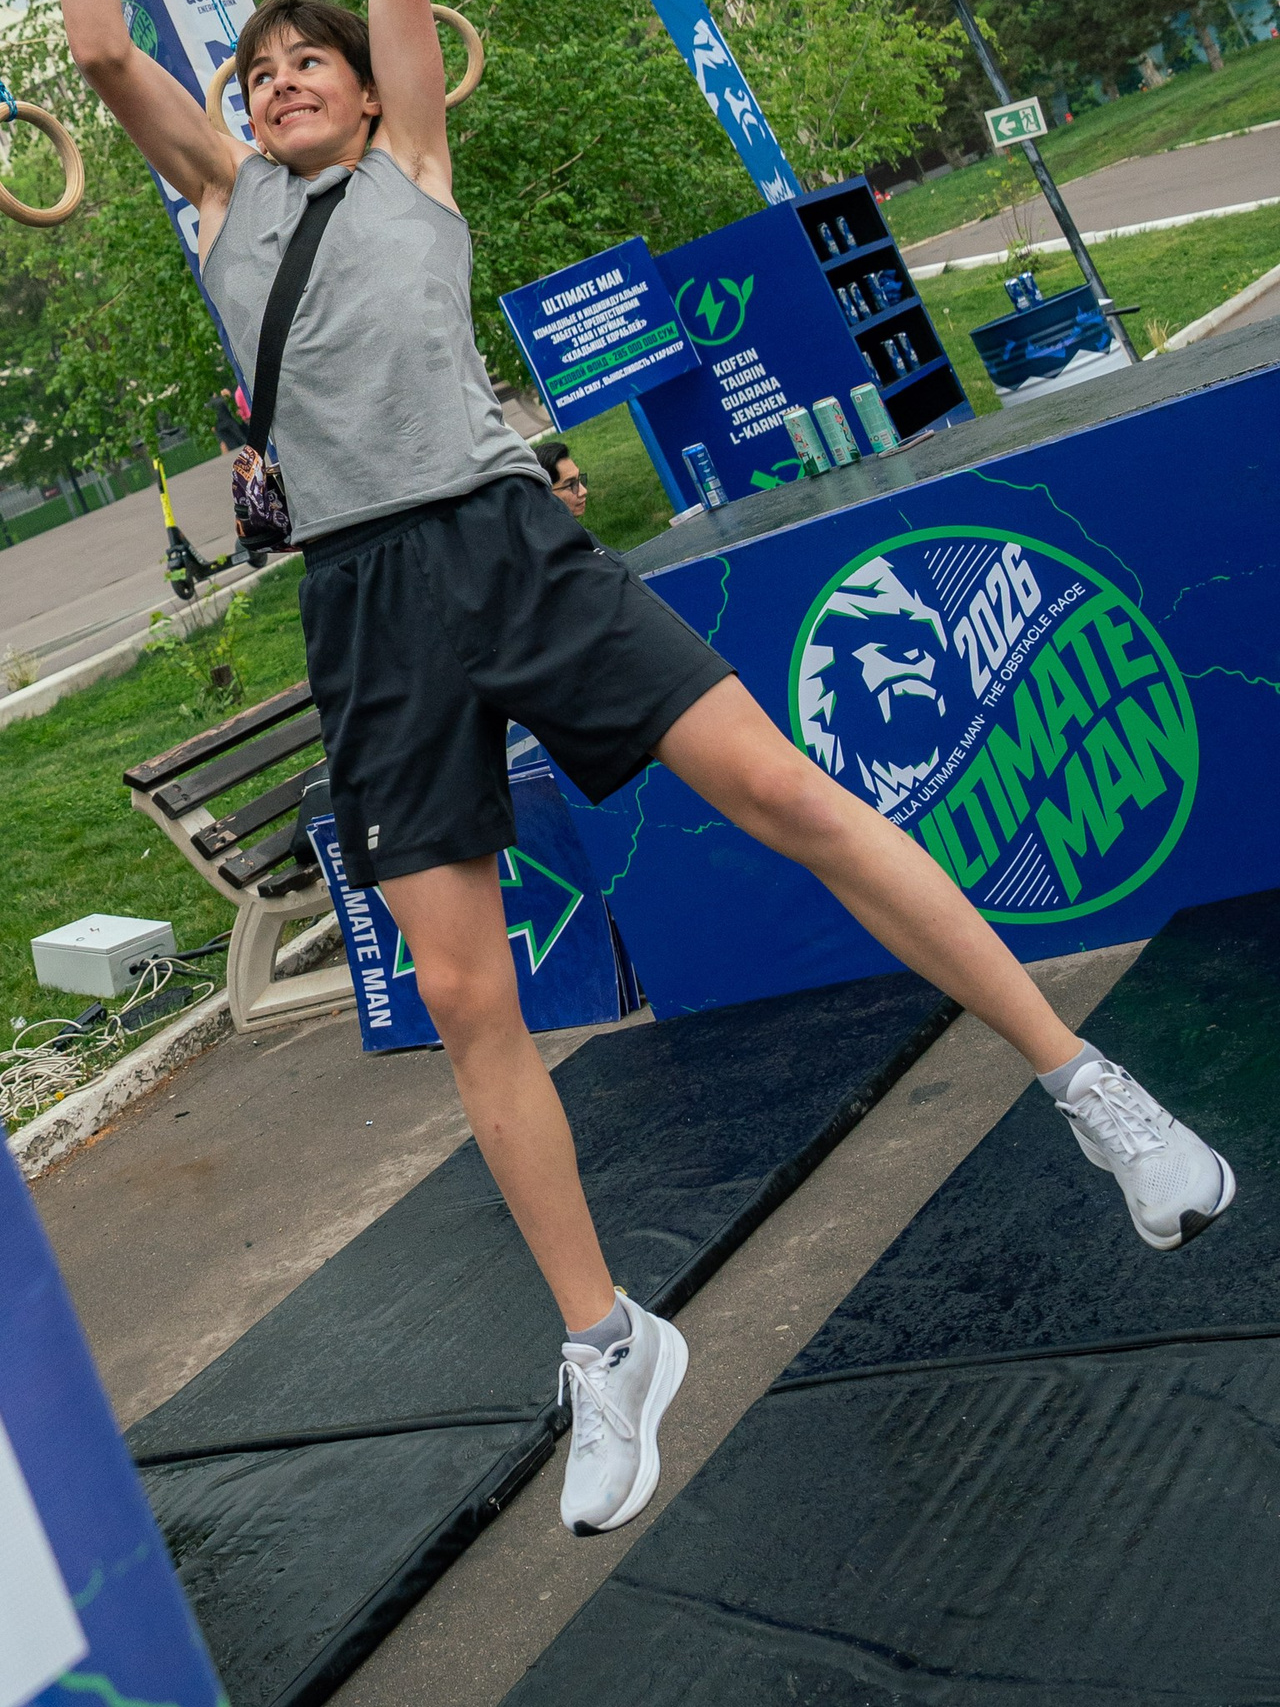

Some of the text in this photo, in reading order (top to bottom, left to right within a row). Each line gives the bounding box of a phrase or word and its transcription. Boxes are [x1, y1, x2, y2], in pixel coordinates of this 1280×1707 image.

[197, 2, 219, 14] ENER
[532, 281, 649, 340] КОМАНДНЫЕ И ИНДИВИДУАЛЬНЫЕ
[541, 268, 624, 316] ULTIMATE MAN
[550, 297, 640, 345] ЗАБЕГИ С ПРЕПЯТСТВИЯМИ
[571, 338, 579, 347] 3
[577, 330, 594, 345] МАЯ
[549, 365, 586, 390] ПРИЗОВОЙ
[587, 356, 608, 373] ФОНД
[628, 340, 643, 354] 000
[642, 334, 658, 347] 000
[555, 386, 585, 408] ИСПЫТАЙ
[602, 357, 650, 385] ВЫНОСЛИВОСТЬ
[654, 340, 684, 361] ХАРАКТЕР
[712, 347, 759, 377] KOFEIN
[720, 364, 766, 393] TAURIN
[722, 377, 781, 412] GUARANA
[731, 392, 787, 426] JENSHEN
[729, 404, 800, 445] L-KARNI
[954, 542, 1041, 699] 2026
[888, 800, 923, 825] RILLA
[918, 747, 966, 801] ULTIMATE
[982, 681, 1006, 708] THE
[1001, 614, 1052, 681] OBSTACLE
[1048, 582, 1086, 617] RACE
[1035, 681, 1187, 905] MAN
[361, 968, 392, 1028] MAN
